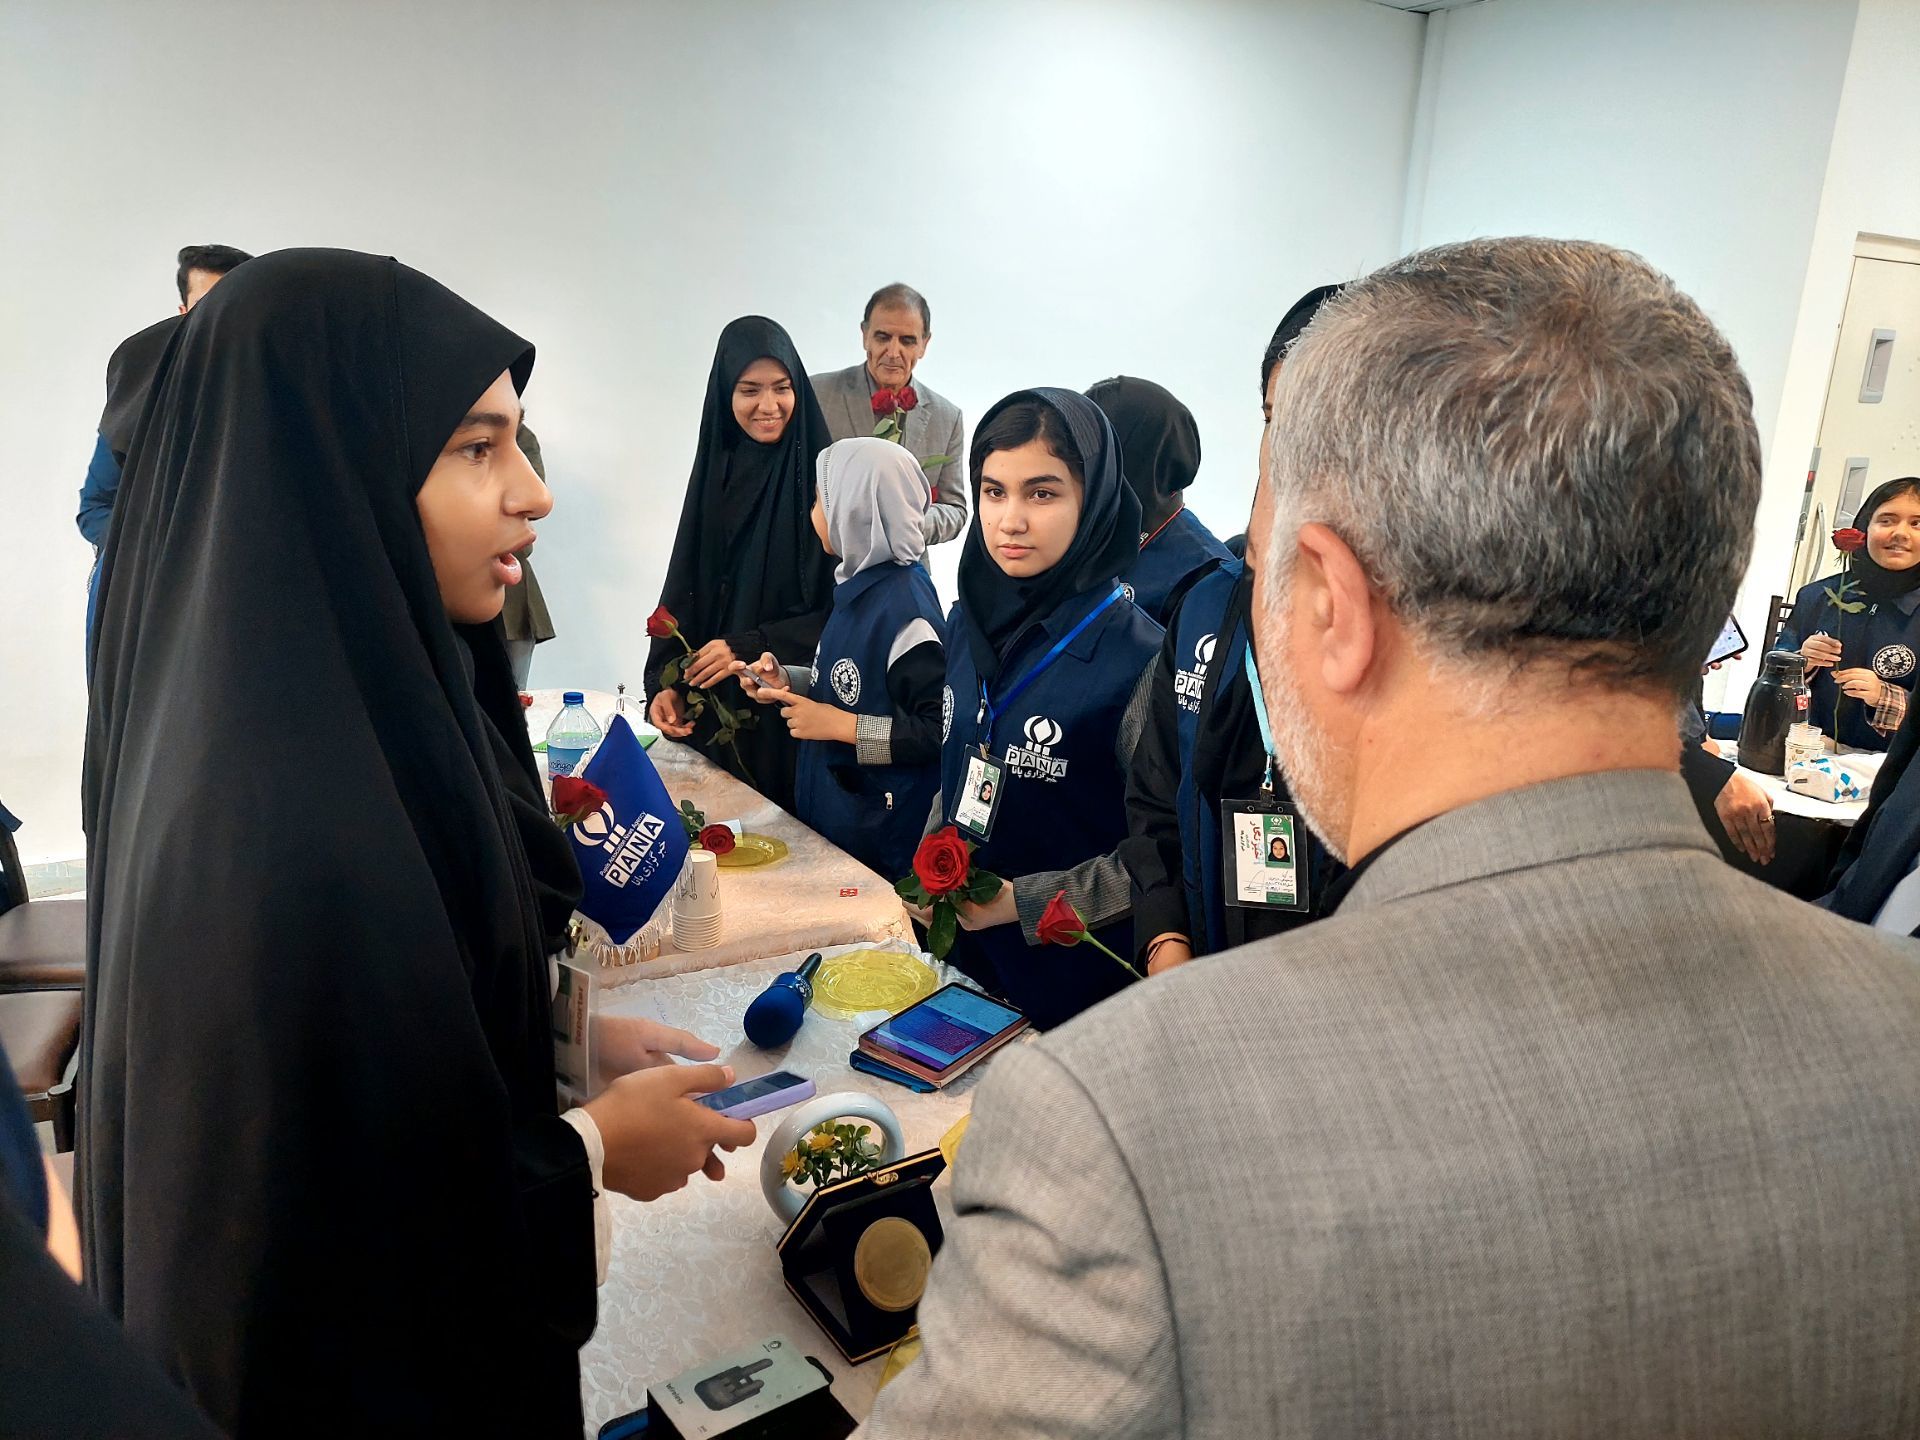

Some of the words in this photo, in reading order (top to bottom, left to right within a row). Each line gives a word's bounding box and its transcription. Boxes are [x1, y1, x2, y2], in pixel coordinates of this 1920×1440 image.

[1006, 749, 1066, 777] PANA
[607, 817, 664, 886] PANA
[575, 987, 584, 1045] Reporter
